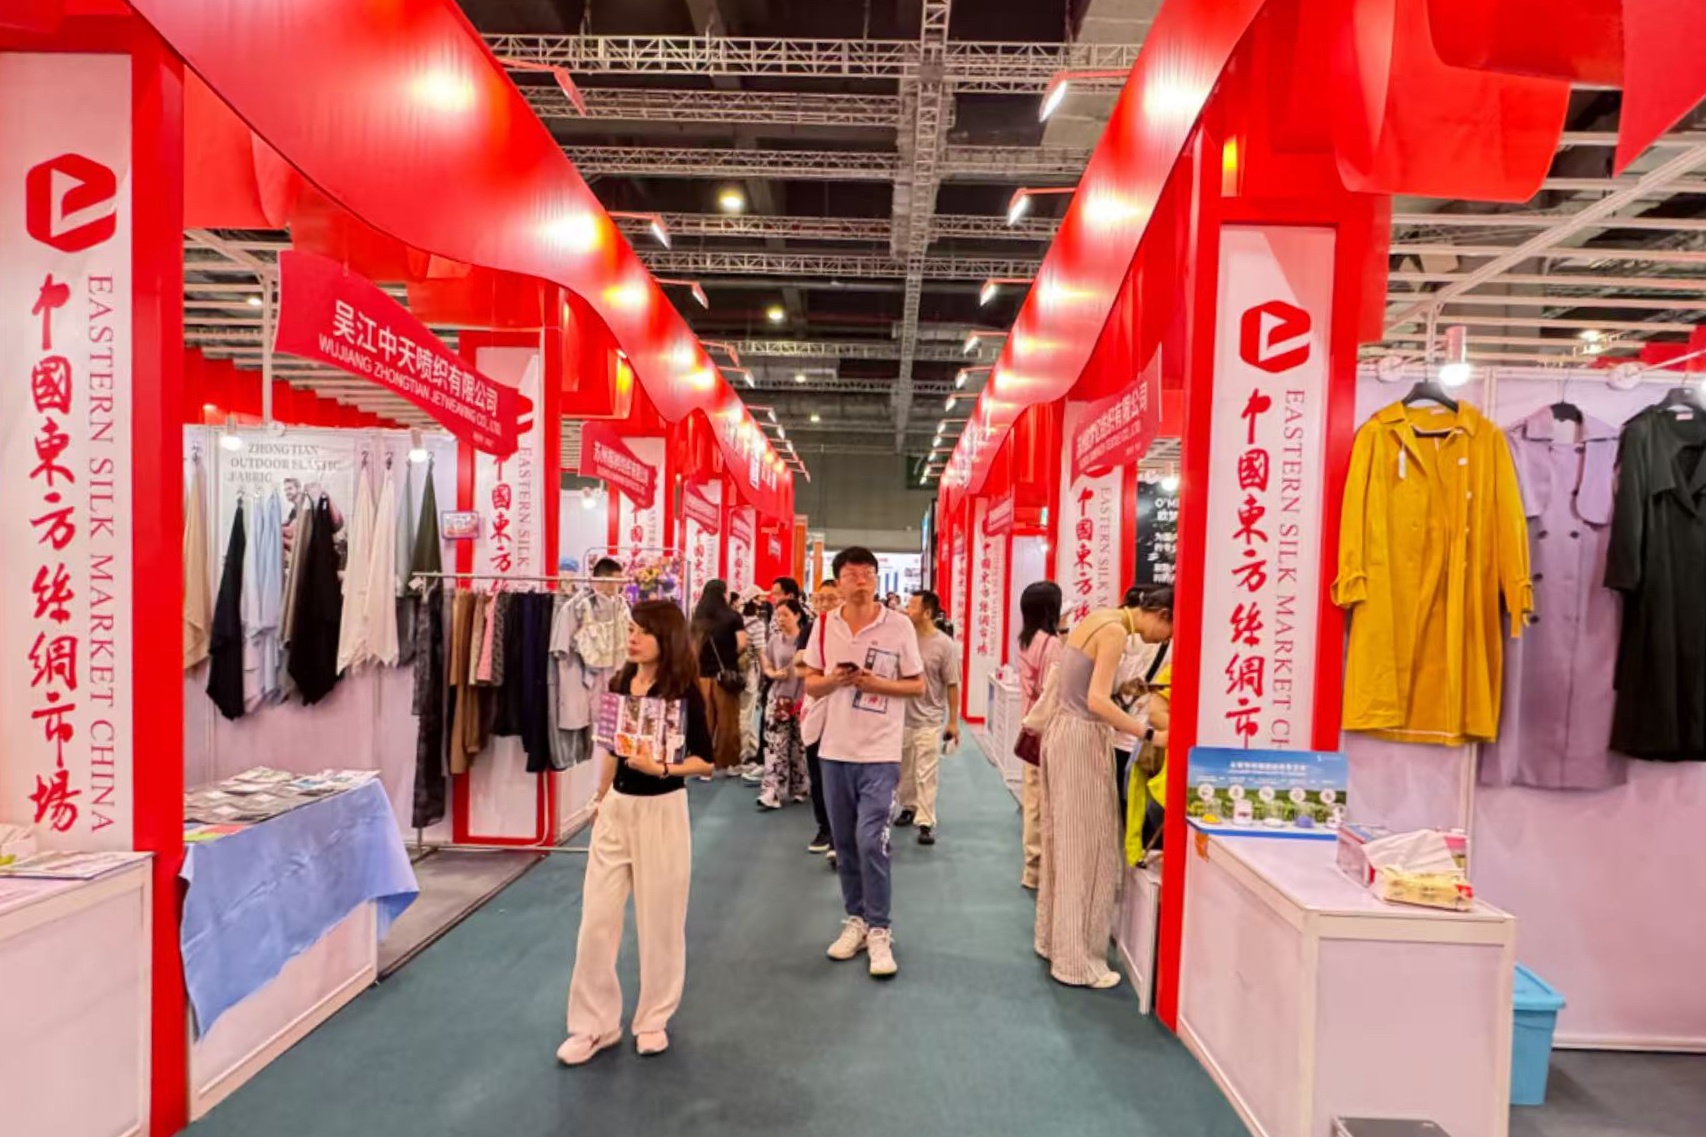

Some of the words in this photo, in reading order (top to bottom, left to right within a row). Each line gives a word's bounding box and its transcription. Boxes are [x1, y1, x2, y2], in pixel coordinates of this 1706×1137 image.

[87, 275, 114, 443] EASTERN
[318, 332, 373, 374] WUJIANG
[373, 360, 431, 401] ZHONGTIAN
[332, 299, 498, 418] 吴江中天喷织有限公司
[228, 470, 273, 484] FABRIC
[230, 457, 290, 470] OUTDOOR
[517, 446, 532, 528] EASTERN
[1280, 389, 1305, 513] EASTERN
[88, 457, 115, 539] SILK
[1099, 487, 1112, 554] EASTERN
[516, 530, 531, 568] SILK
[1097, 557, 1110, 591] SILK
[1277, 523, 1299, 583] SILK
[89, 554, 115, 708] MARKET
[1271, 594, 1296, 711] MARKET
[89, 719, 116, 833] CHINA
